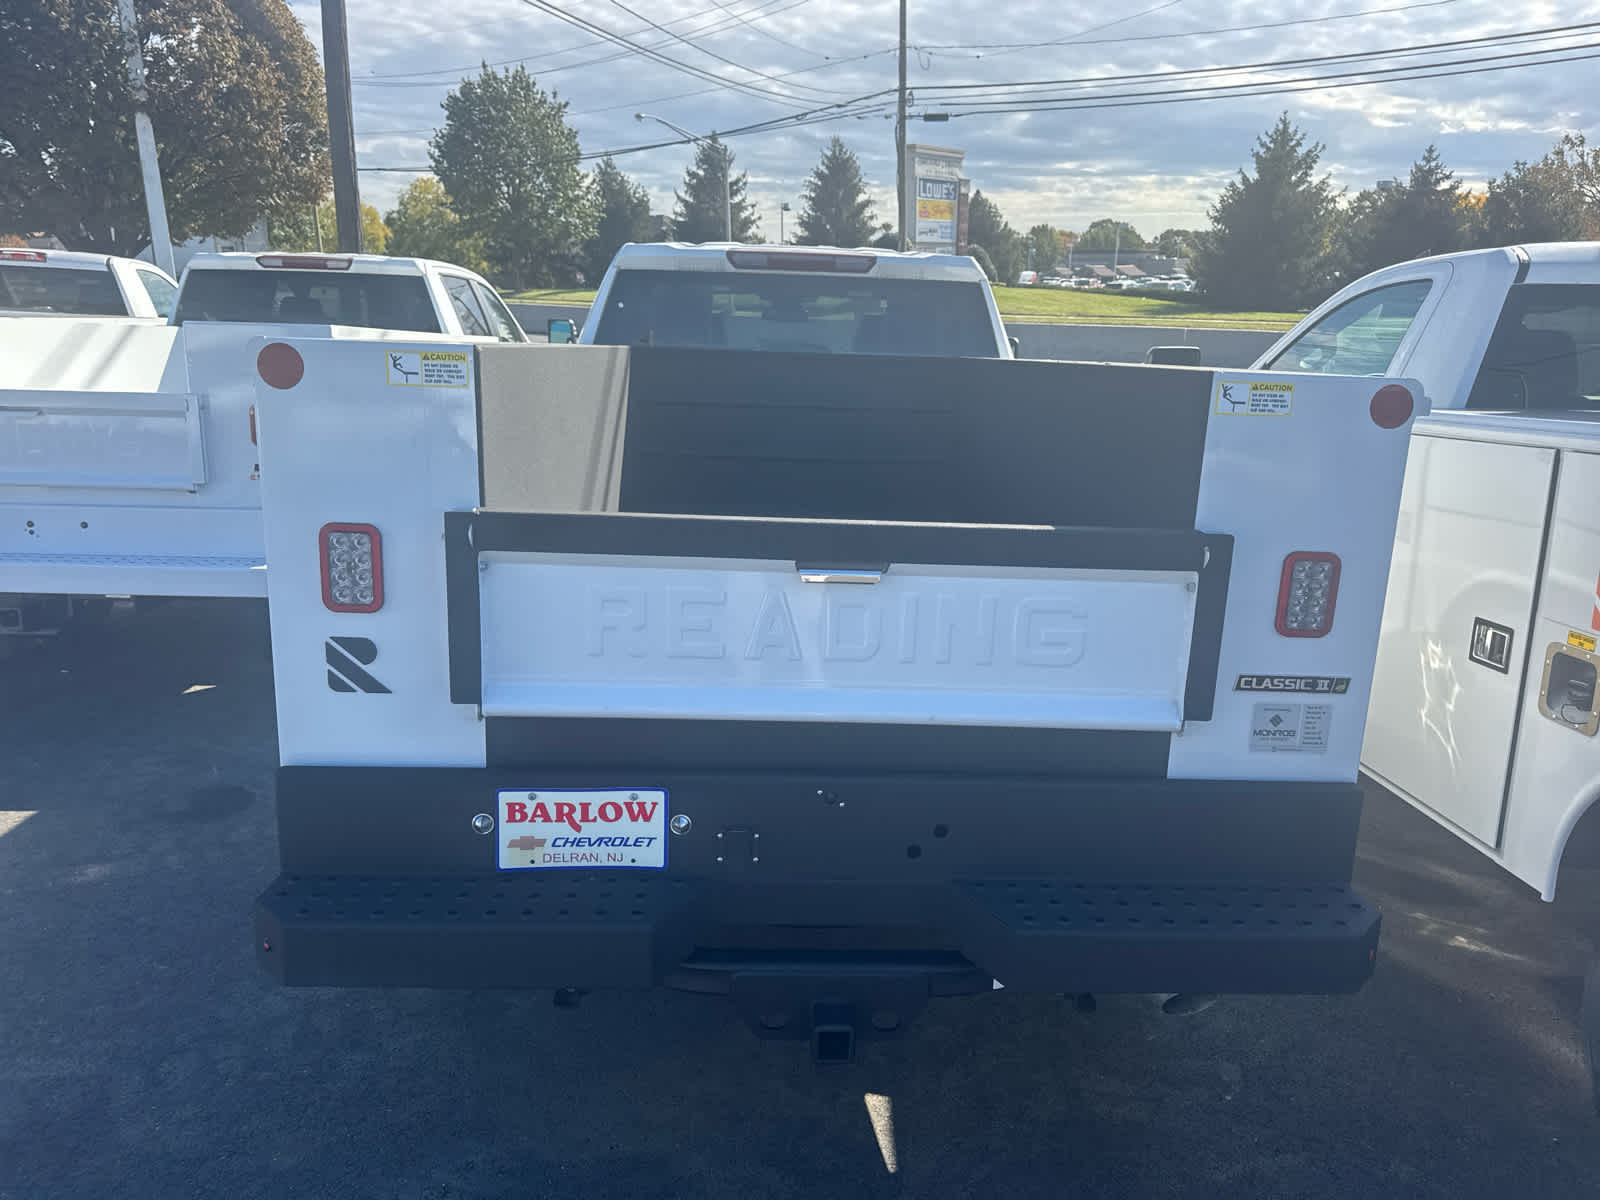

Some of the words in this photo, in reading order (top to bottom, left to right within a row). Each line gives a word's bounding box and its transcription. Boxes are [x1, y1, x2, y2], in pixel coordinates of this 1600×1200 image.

[919, 179, 955, 199] LOWE'S
[430, 353, 466, 361] CAUTION
[586, 584, 1089, 667] READING
[1240, 677, 1313, 690] CLASSIC
[1316, 679, 1330, 690] II
[505, 801, 658, 833] BARLOW
[551, 836, 657, 848] CHEVROLET
[543, 852, 602, 863] DELRAN,
[607, 852, 624, 863] NJ
